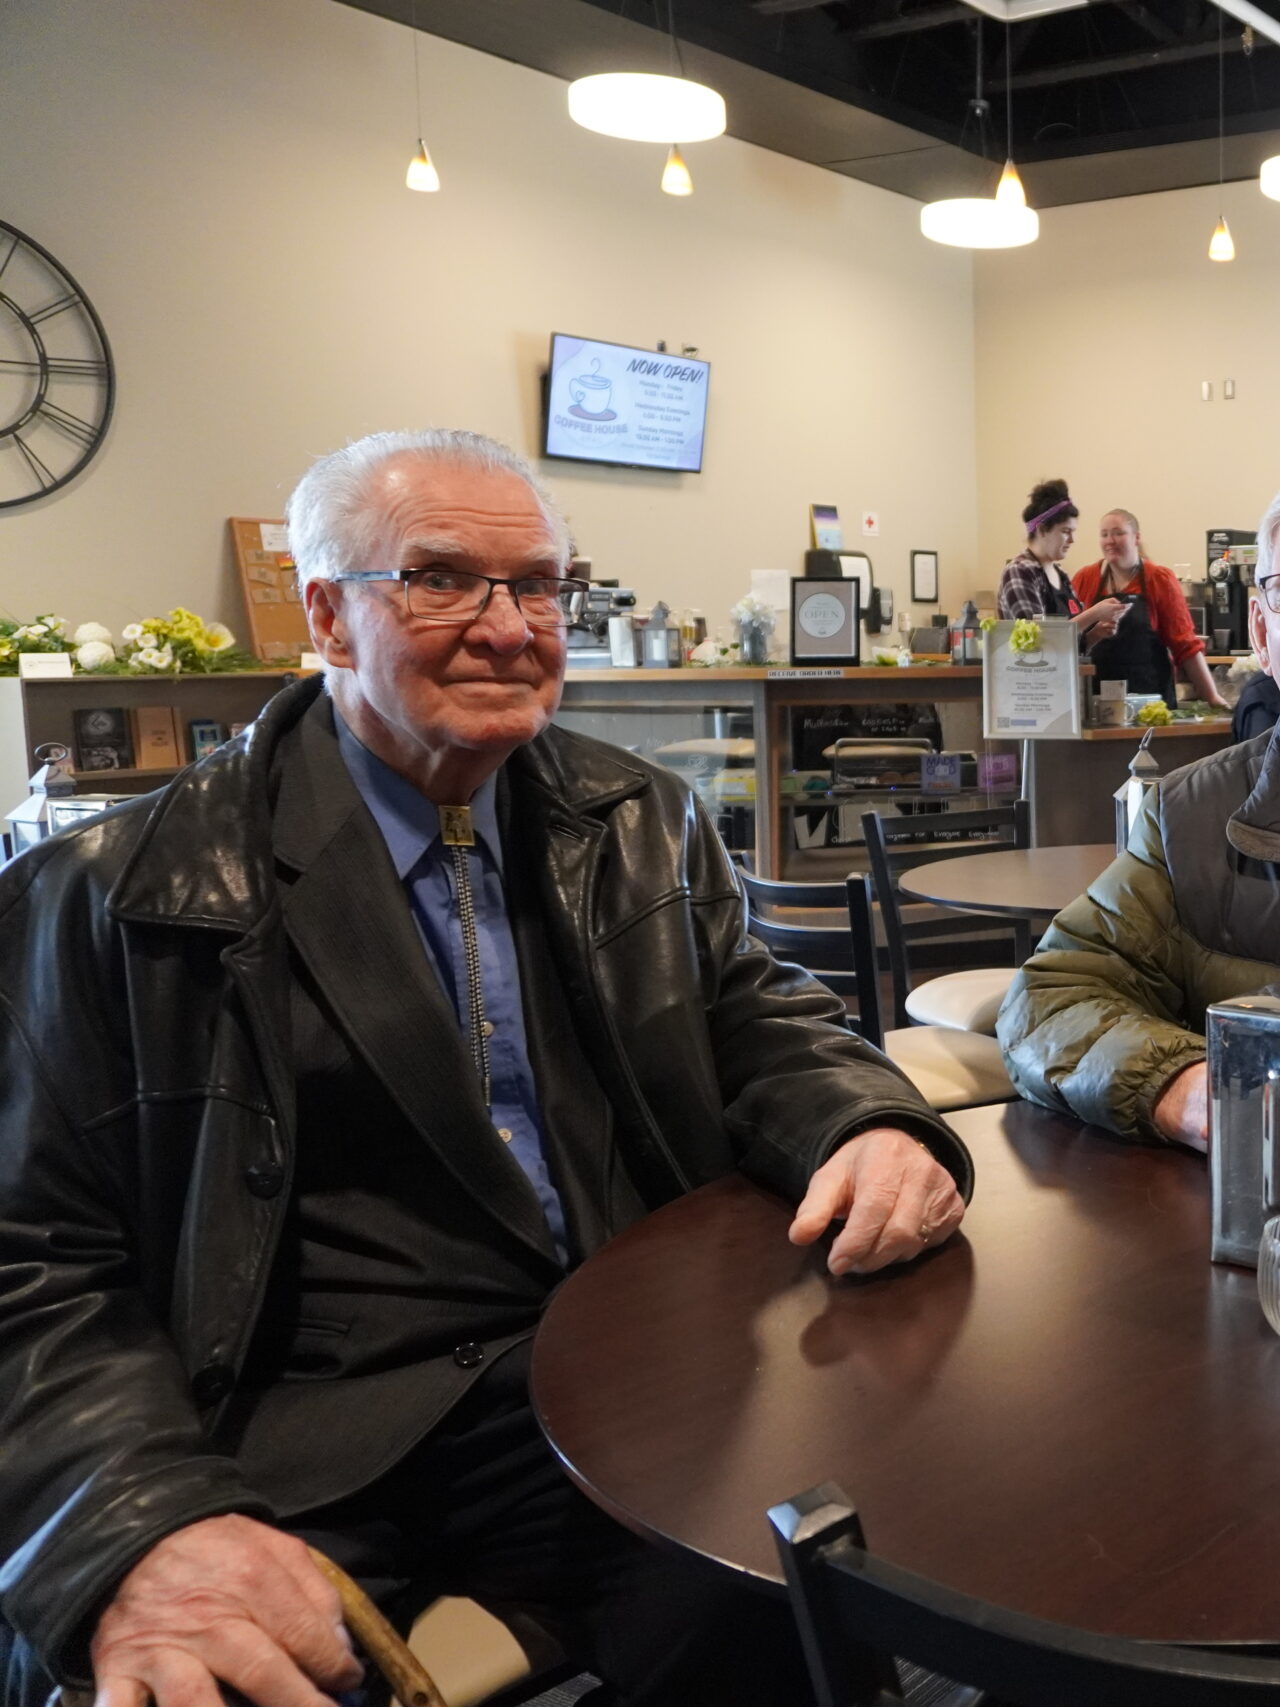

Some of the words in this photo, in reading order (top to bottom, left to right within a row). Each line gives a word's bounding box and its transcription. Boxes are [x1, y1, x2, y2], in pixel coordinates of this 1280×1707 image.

[626, 358, 664, 376] NOW
[663, 363, 705, 384] OPEN!
[554, 414, 593, 433] COFFEE
[594, 423, 629, 435] HOUSE
